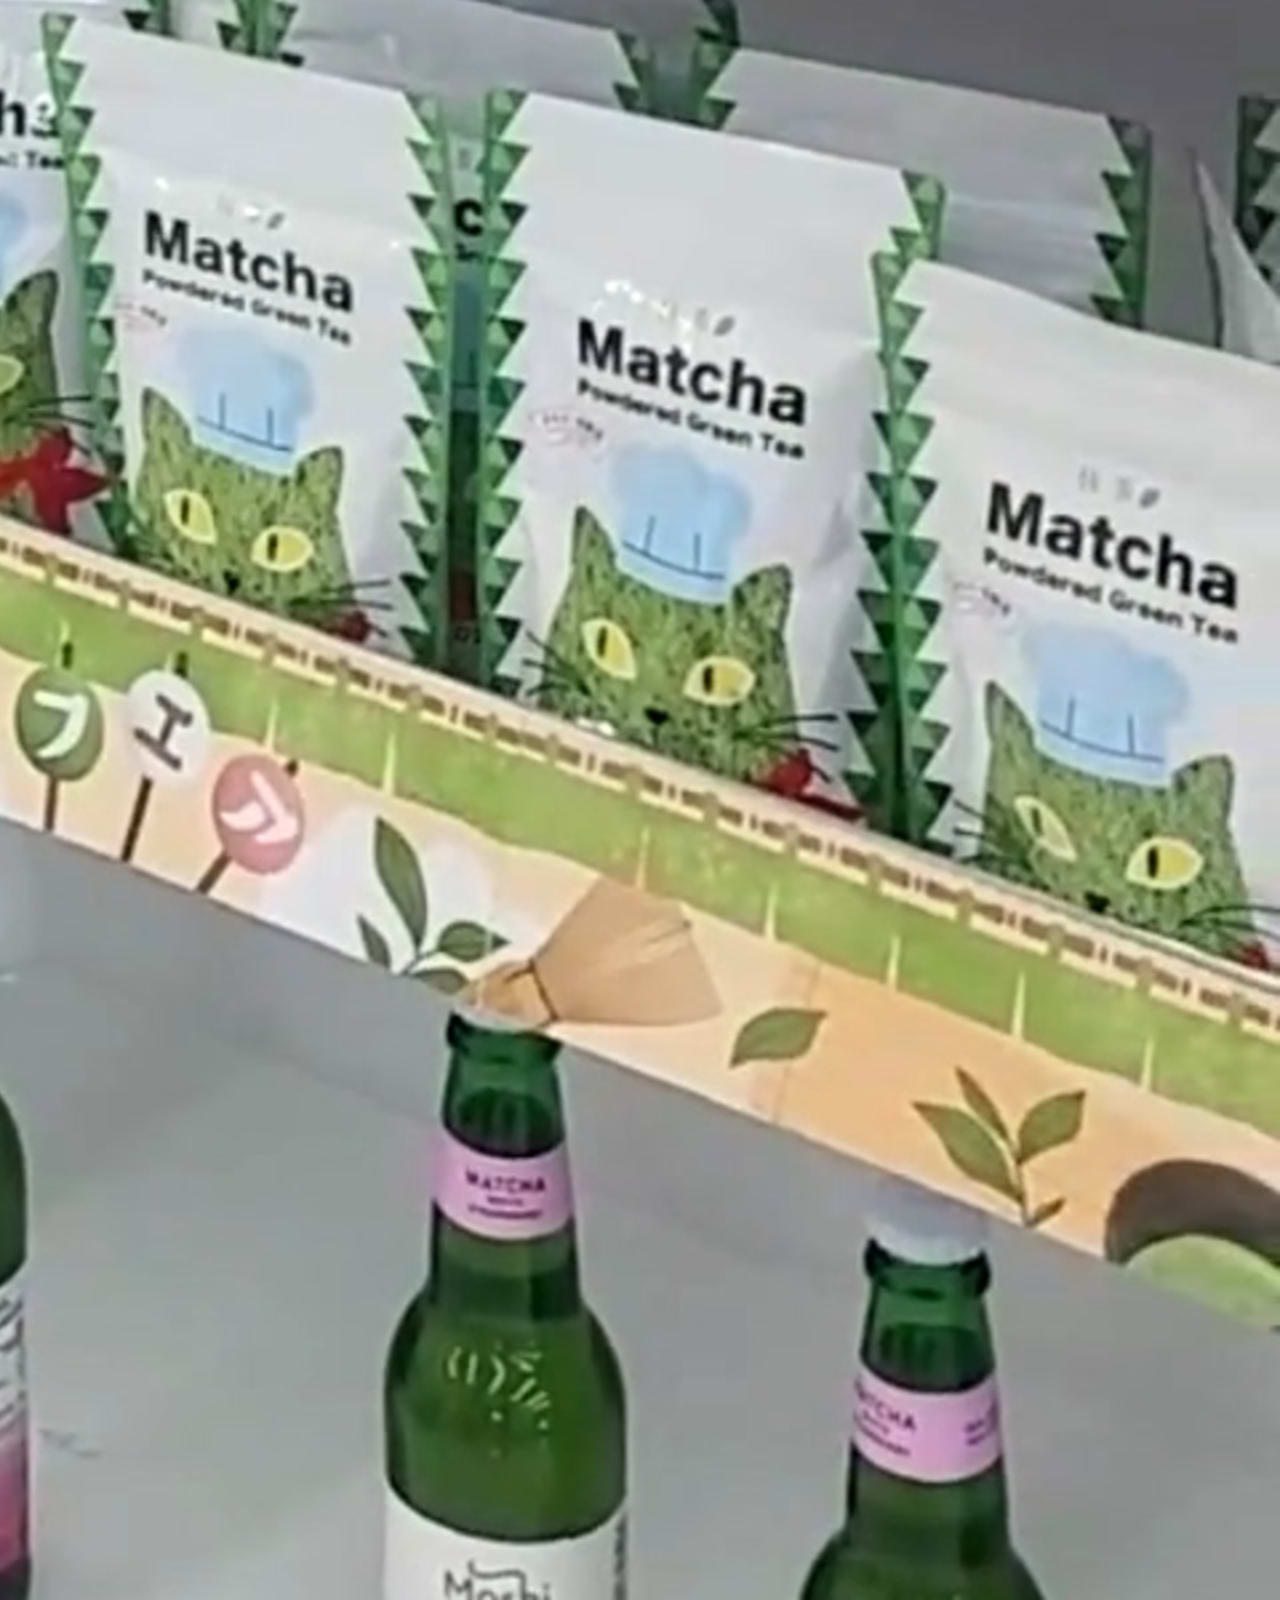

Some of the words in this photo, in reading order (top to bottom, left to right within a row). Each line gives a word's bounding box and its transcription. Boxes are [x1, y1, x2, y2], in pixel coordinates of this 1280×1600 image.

[142, 266, 246, 314] Powdered
[250, 296, 313, 333] Green
[144, 209, 356, 315] Matcha
[576, 316, 808, 430] Matcha
[576, 375, 682, 428] Powdered
[685, 409, 754, 450] Green
[984, 479, 1239, 610] Matcha
[982, 546, 1105, 612] Powdered
[1108, 584, 1185, 633] Green
[462, 1172, 548, 1197] MATCHA
